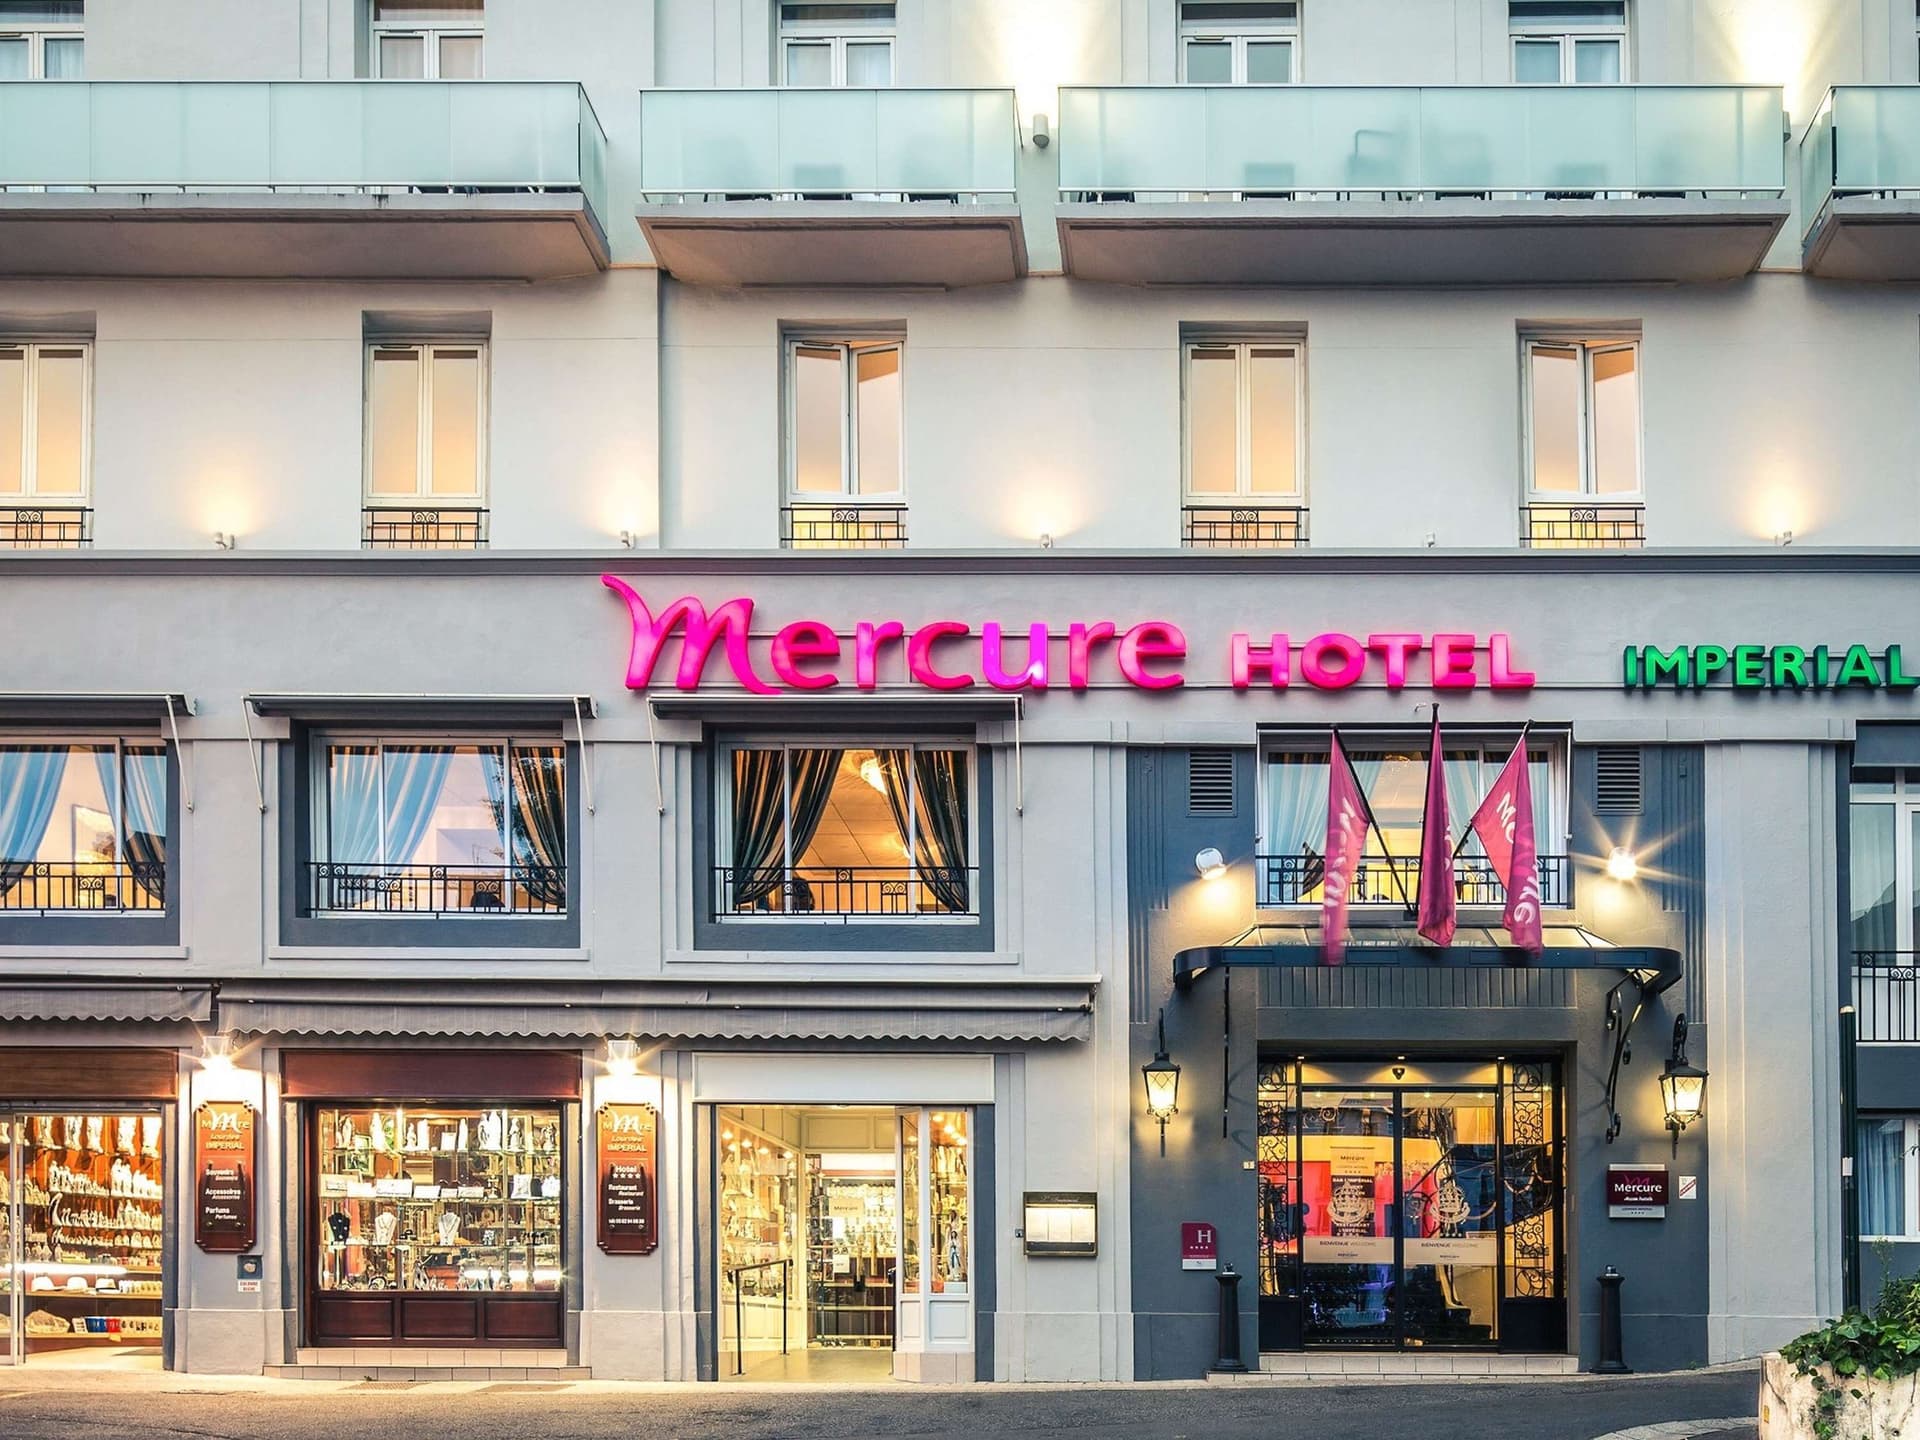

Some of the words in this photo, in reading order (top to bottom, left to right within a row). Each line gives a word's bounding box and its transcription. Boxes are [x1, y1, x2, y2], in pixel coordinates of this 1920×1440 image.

[600, 573, 1188, 695] Mercure
[1230, 633, 1536, 690] HOTEL
[1622, 643, 1920, 690] IMPERIAL
[1614, 1183, 1662, 1193] Mercure
[1197, 1229, 1212, 1243] H
